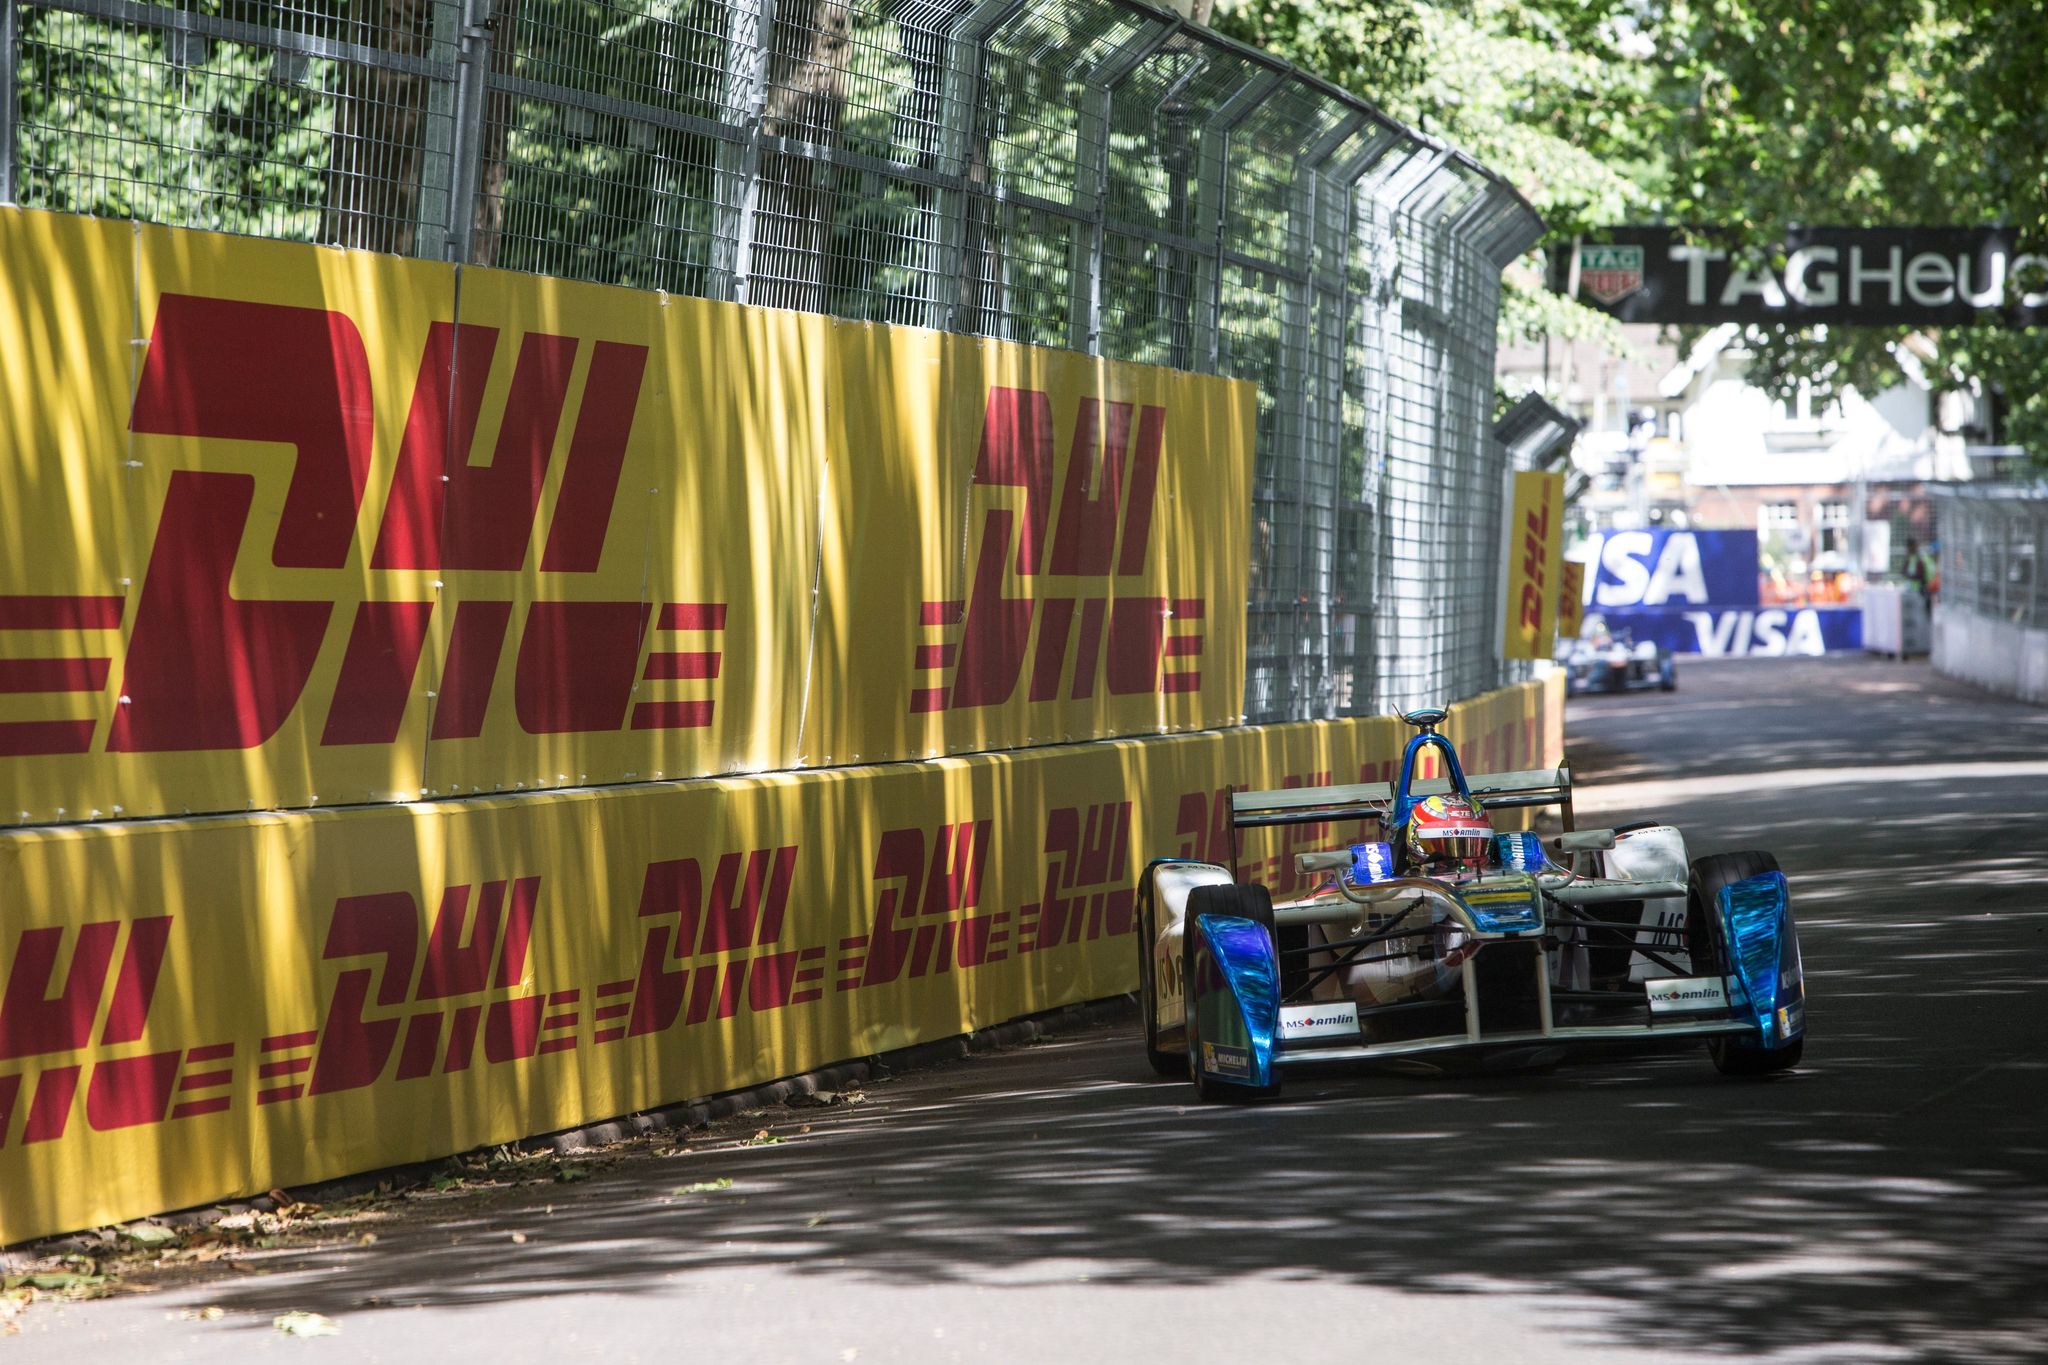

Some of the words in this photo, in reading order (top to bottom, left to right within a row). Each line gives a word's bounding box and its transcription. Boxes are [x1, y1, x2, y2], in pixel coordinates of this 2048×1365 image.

[105, 292, 653, 753] DHL
[952, 386, 1167, 708] DHL
[1521, 504, 1549, 633] DHL
[1572, 532, 1709, 606] ISA
[1682, 609, 1826, 657] VISA
[1036, 801, 1139, 949] DHL
[1442, 829, 1454, 837] MS
[628, 846, 798, 1037] DHL
[863, 820, 992, 986] DHL
[308, 876, 546, 1097] DHL
[1286, 1020, 1305, 1028] MS
[1651, 993, 1671, 1001] MS
[1217, 1053, 1248, 1067] MICHELIN
